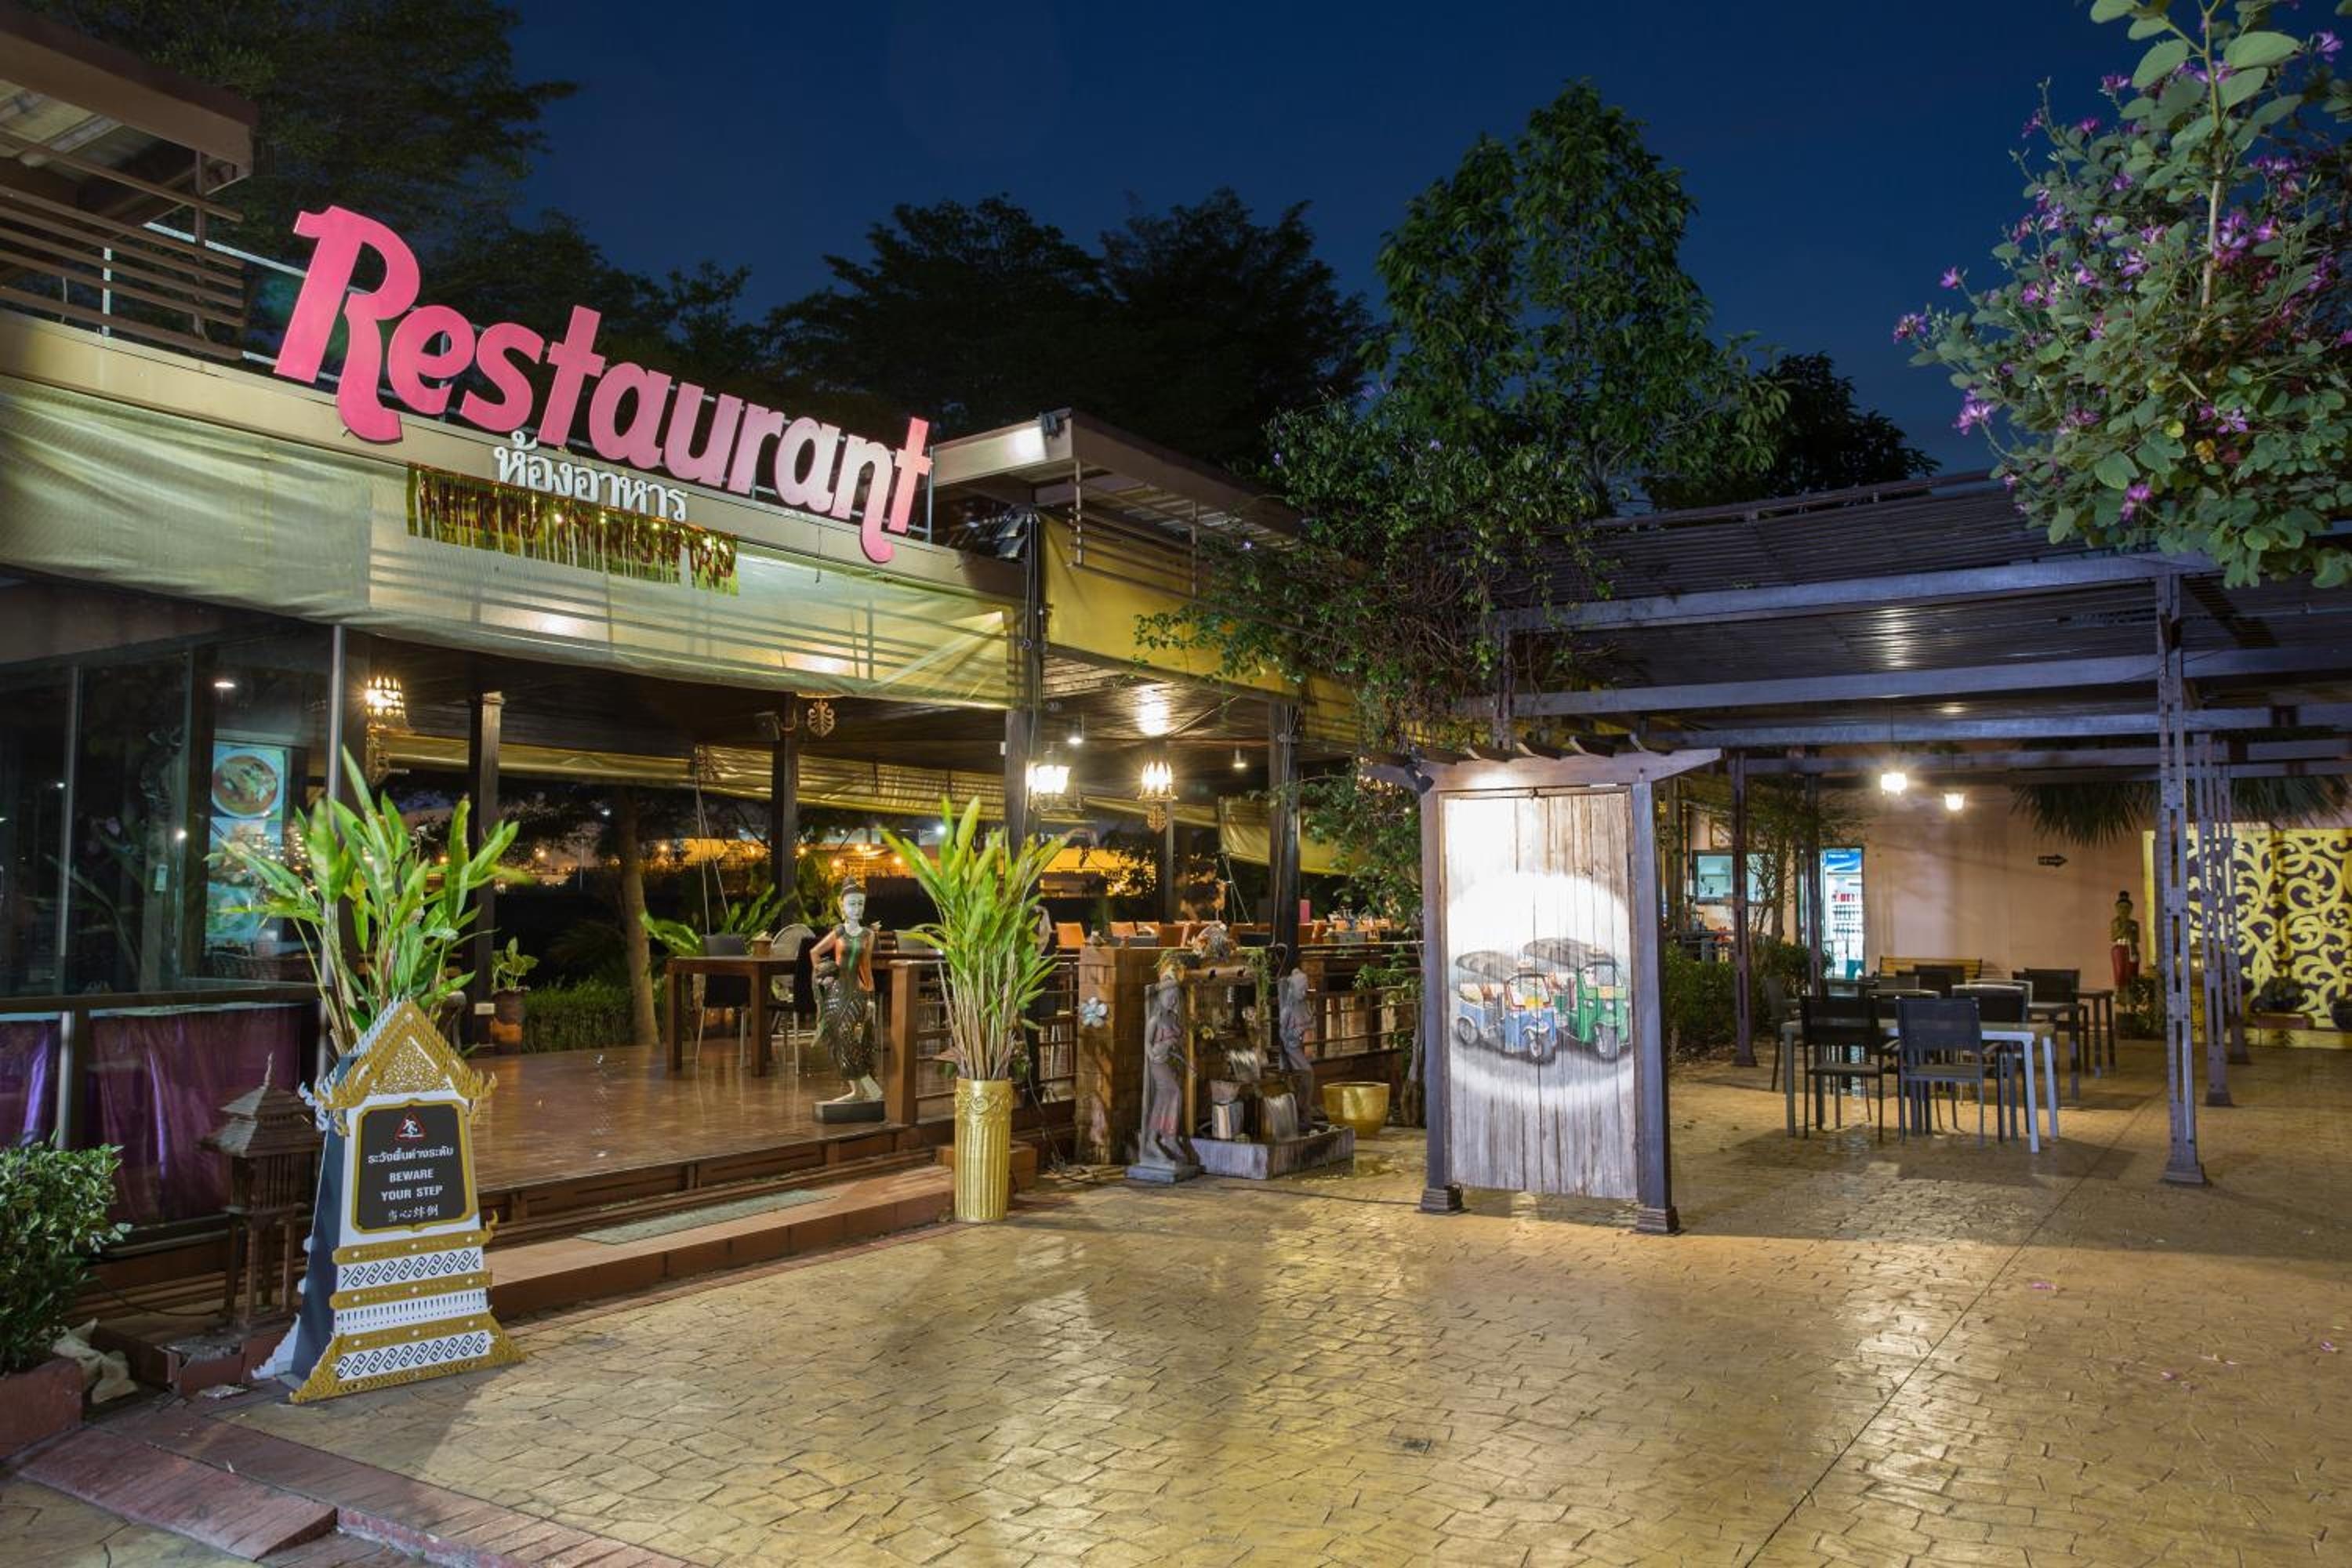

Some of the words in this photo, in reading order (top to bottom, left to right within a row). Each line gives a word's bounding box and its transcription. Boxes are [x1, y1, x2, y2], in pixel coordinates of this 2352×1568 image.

[273, 205, 932, 562] Restaurant
[493, 430, 688, 522] ห้องอาหาร
[381, 1189, 412, 1202] YOUR
[416, 1185, 443, 1197] STEP
[389, 1168, 434, 1183] BEWARE
